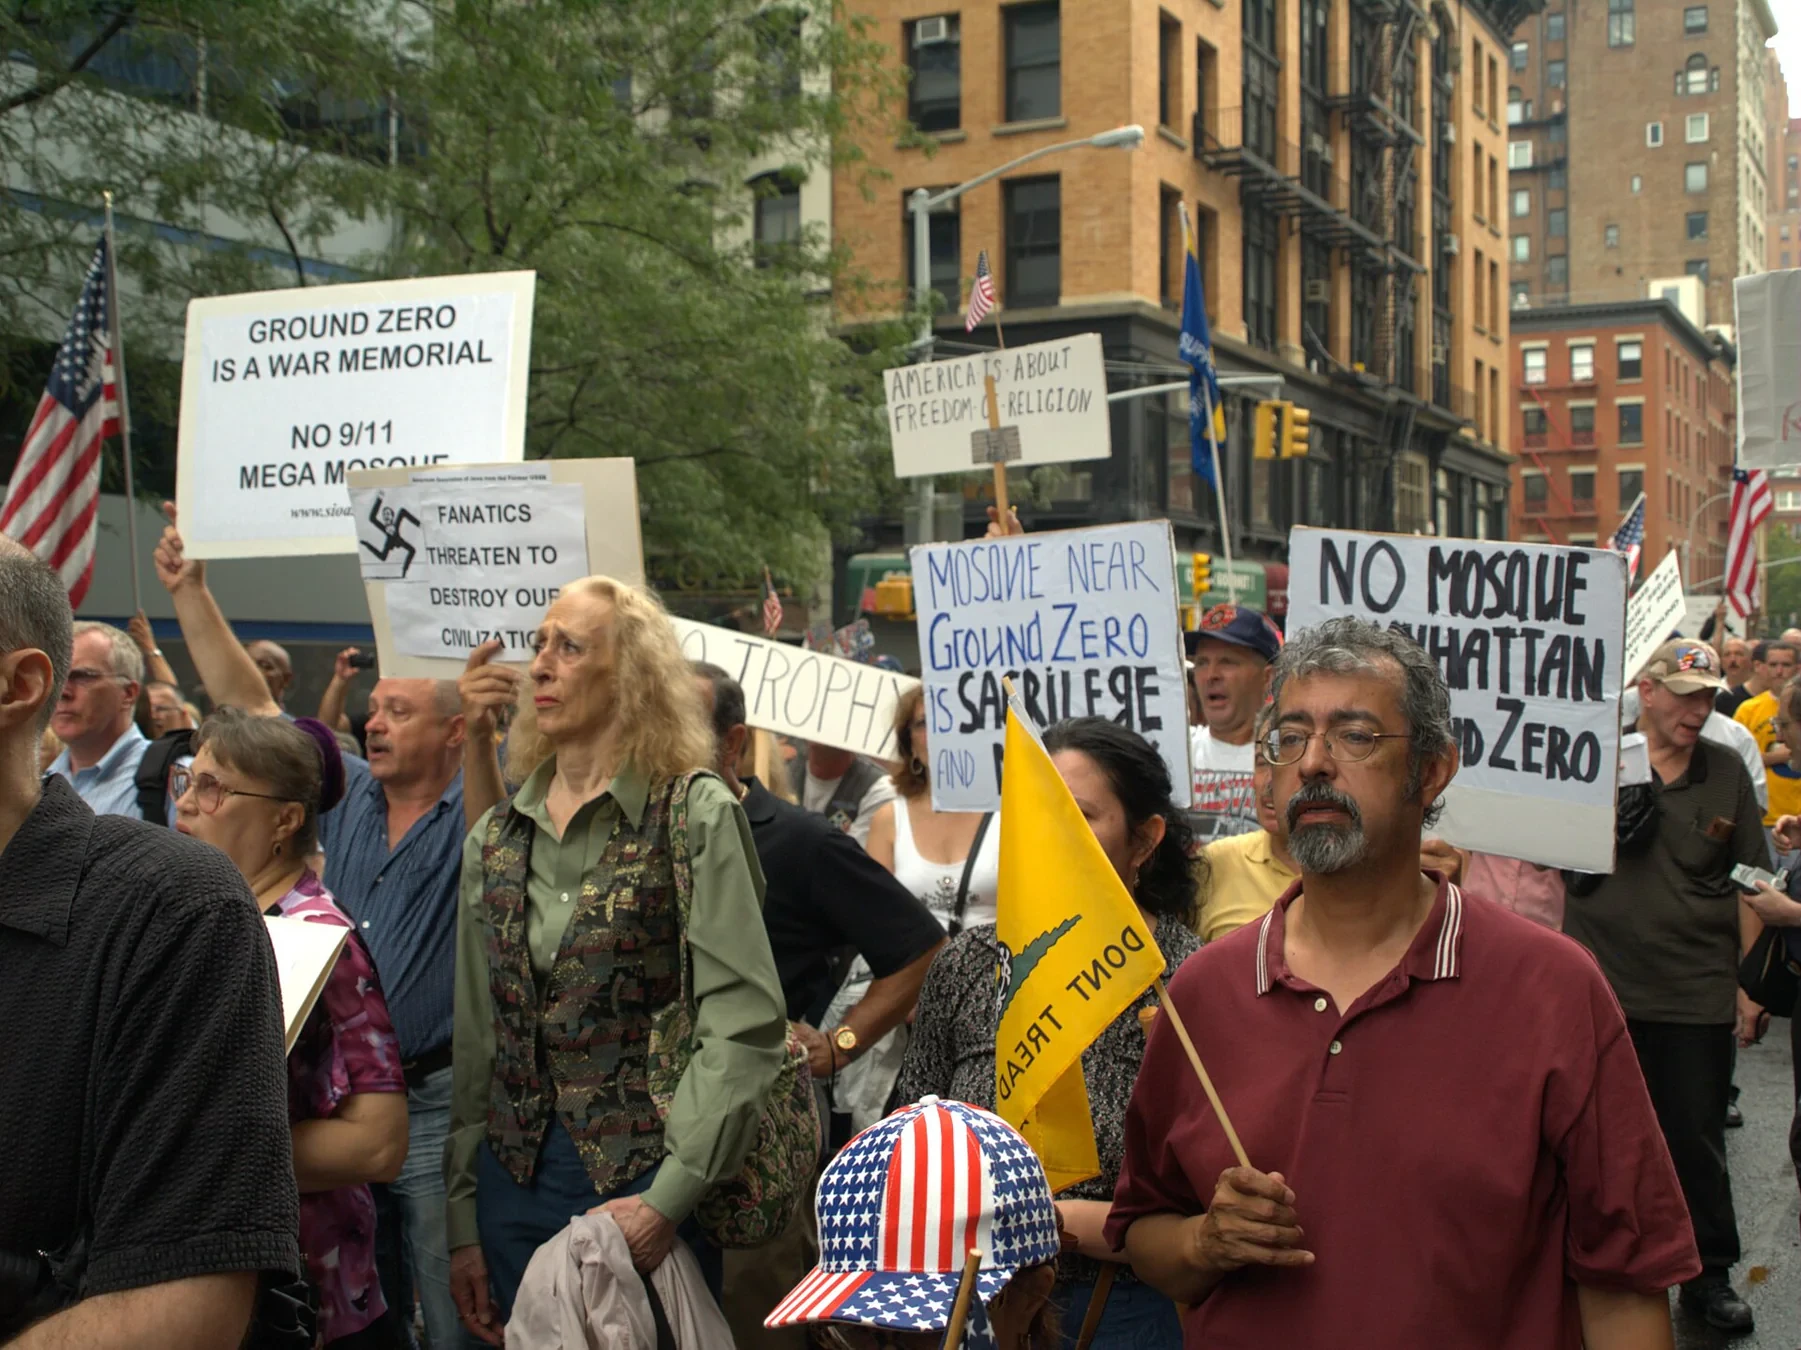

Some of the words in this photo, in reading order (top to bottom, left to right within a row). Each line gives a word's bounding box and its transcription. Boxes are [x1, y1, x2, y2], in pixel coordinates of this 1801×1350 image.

[249, 311, 369, 344] GROUND
[377, 304, 456, 334] ZERO
[212, 358, 236, 382] IS
[243, 356, 260, 380] A
[268, 350, 331, 377] WAR
[338, 339, 492, 373] MEMORIAL
[891, 362, 977, 402] AMERICA
[983, 358, 1002, 382] IS
[1013, 346, 1072, 381] ABOUT
[894, 398, 973, 433] FREEDOM
[1008, 388, 1094, 418] RELIGION
[290, 423, 332, 449] NO
[339, 420, 393, 448] 9/11
[239, 460, 316, 489] MEGA
[438, 504, 532, 524] FANATICS
[426, 546, 521, 565] THREATEN
[527, 545, 558, 564] TO
[1068, 540, 1160, 594] NEAR
[430, 587, 508, 607] DESTROY
[1319, 537, 1406, 614] NO
[1428, 545, 1590, 626] MOSQUE
[441, 628, 538, 649] CIVILIZATIO
[1051, 603, 1149, 662] ZERO
[929, 685, 954, 734] IS
[1488, 696, 1601, 784] ZERO
[937, 748, 975, 789] AND
